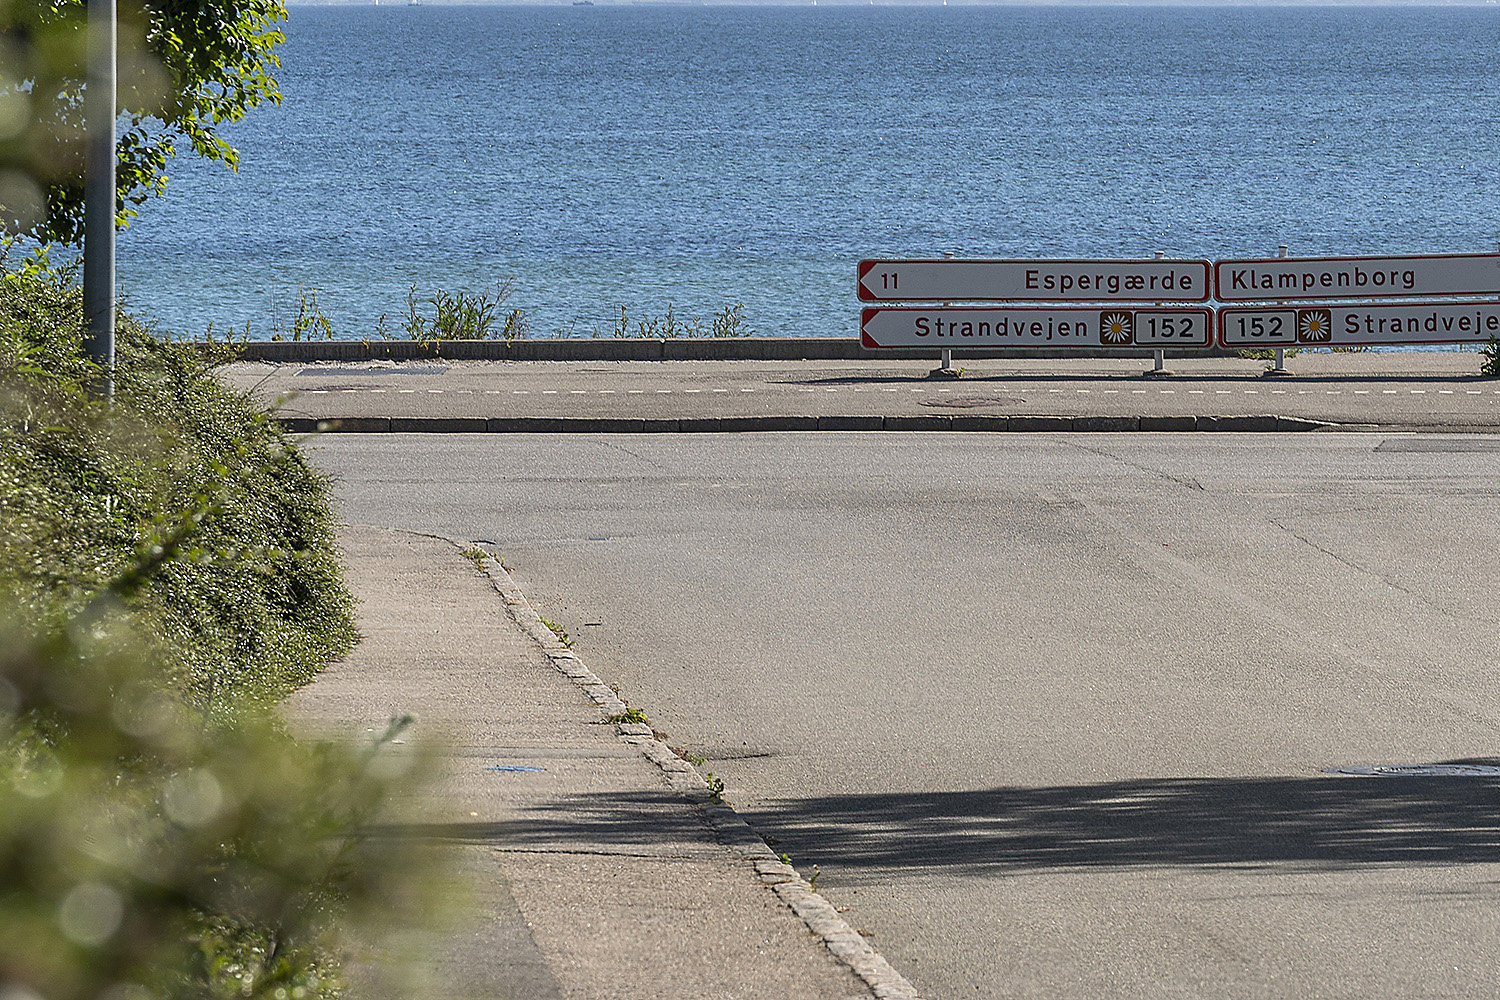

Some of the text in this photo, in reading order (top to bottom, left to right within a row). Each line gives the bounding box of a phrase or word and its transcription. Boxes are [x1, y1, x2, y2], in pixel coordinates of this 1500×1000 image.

[881, 269, 1193, 294] 11 Espergærde
[1231, 268, 1416, 290] Klampenborg
[914, 316, 1195, 341] Strandvejen 152
[1237, 317, 1283, 338] 152
